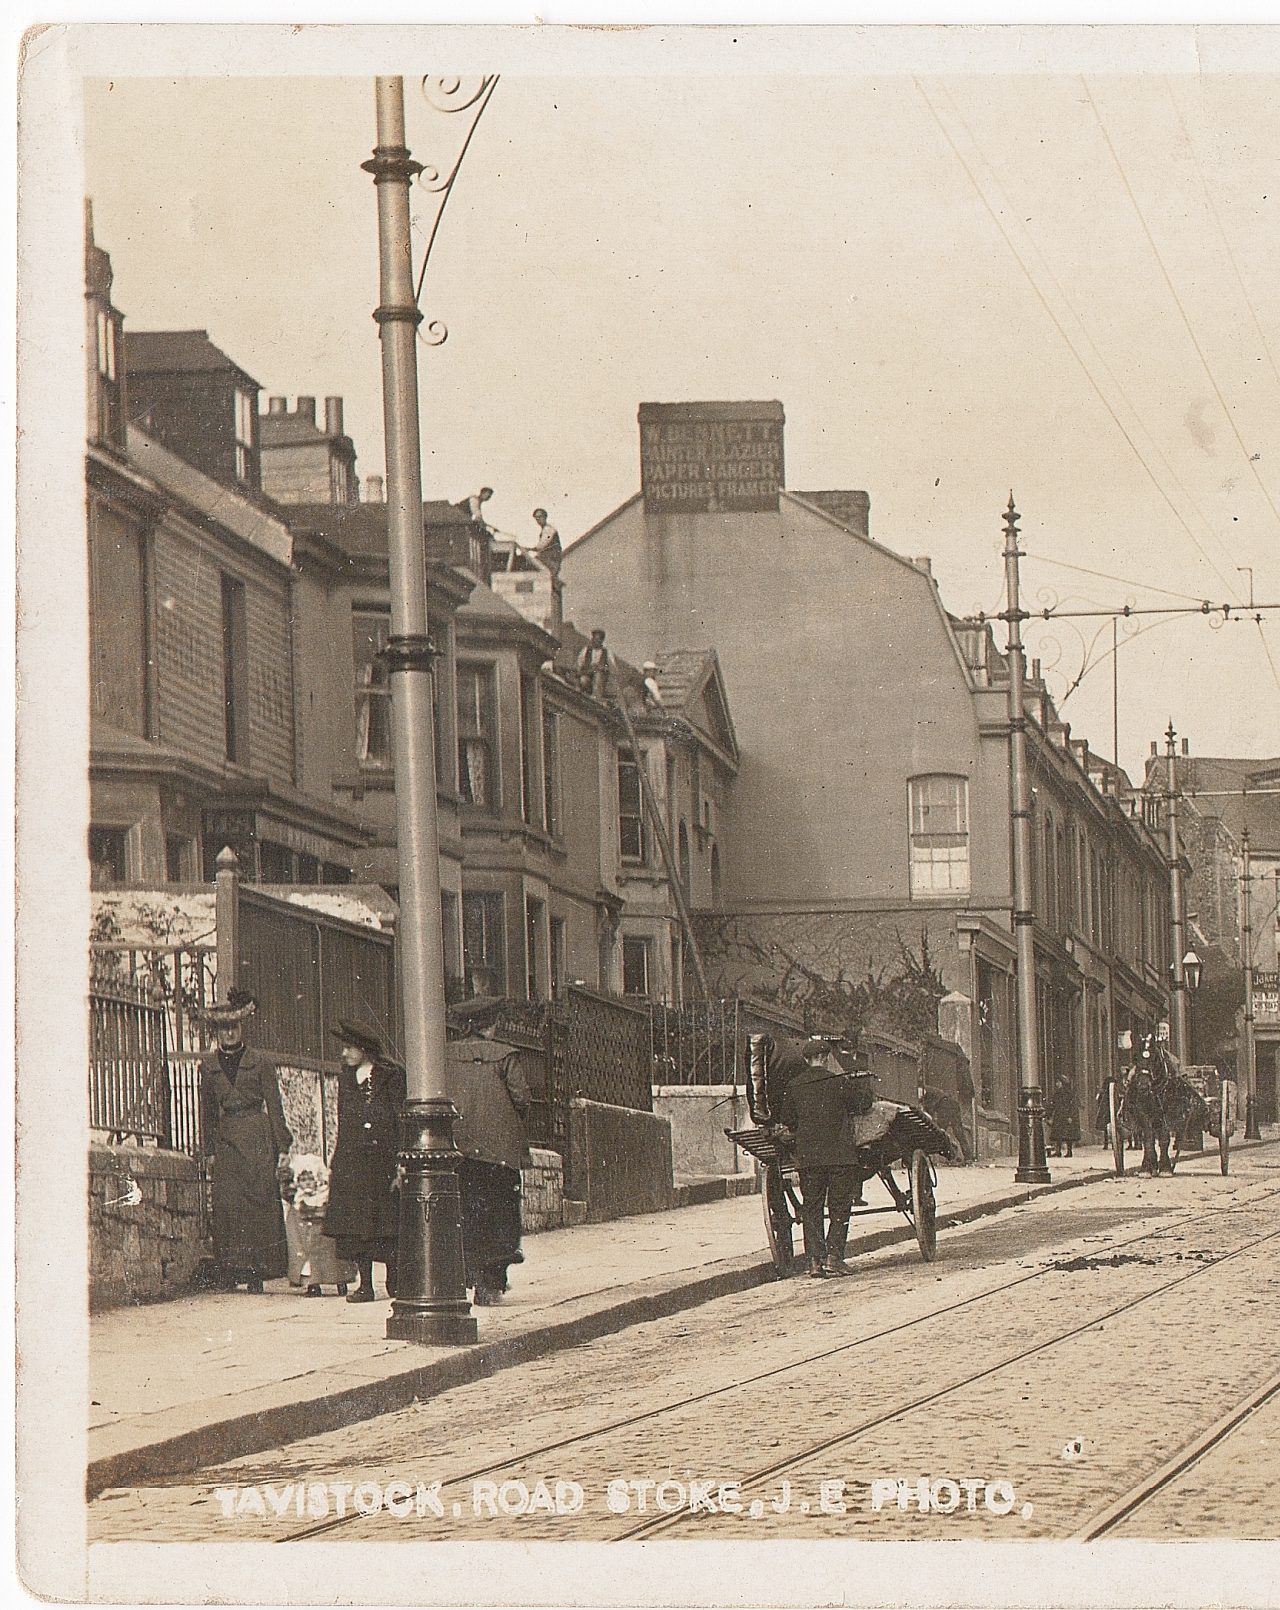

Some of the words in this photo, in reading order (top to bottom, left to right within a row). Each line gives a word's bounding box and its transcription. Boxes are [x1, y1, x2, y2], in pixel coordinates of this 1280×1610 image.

[644, 463, 700, 481] PAPER
[646, 482, 715, 499] PICTURES
[718, 481, 779, 498] FRAMED
